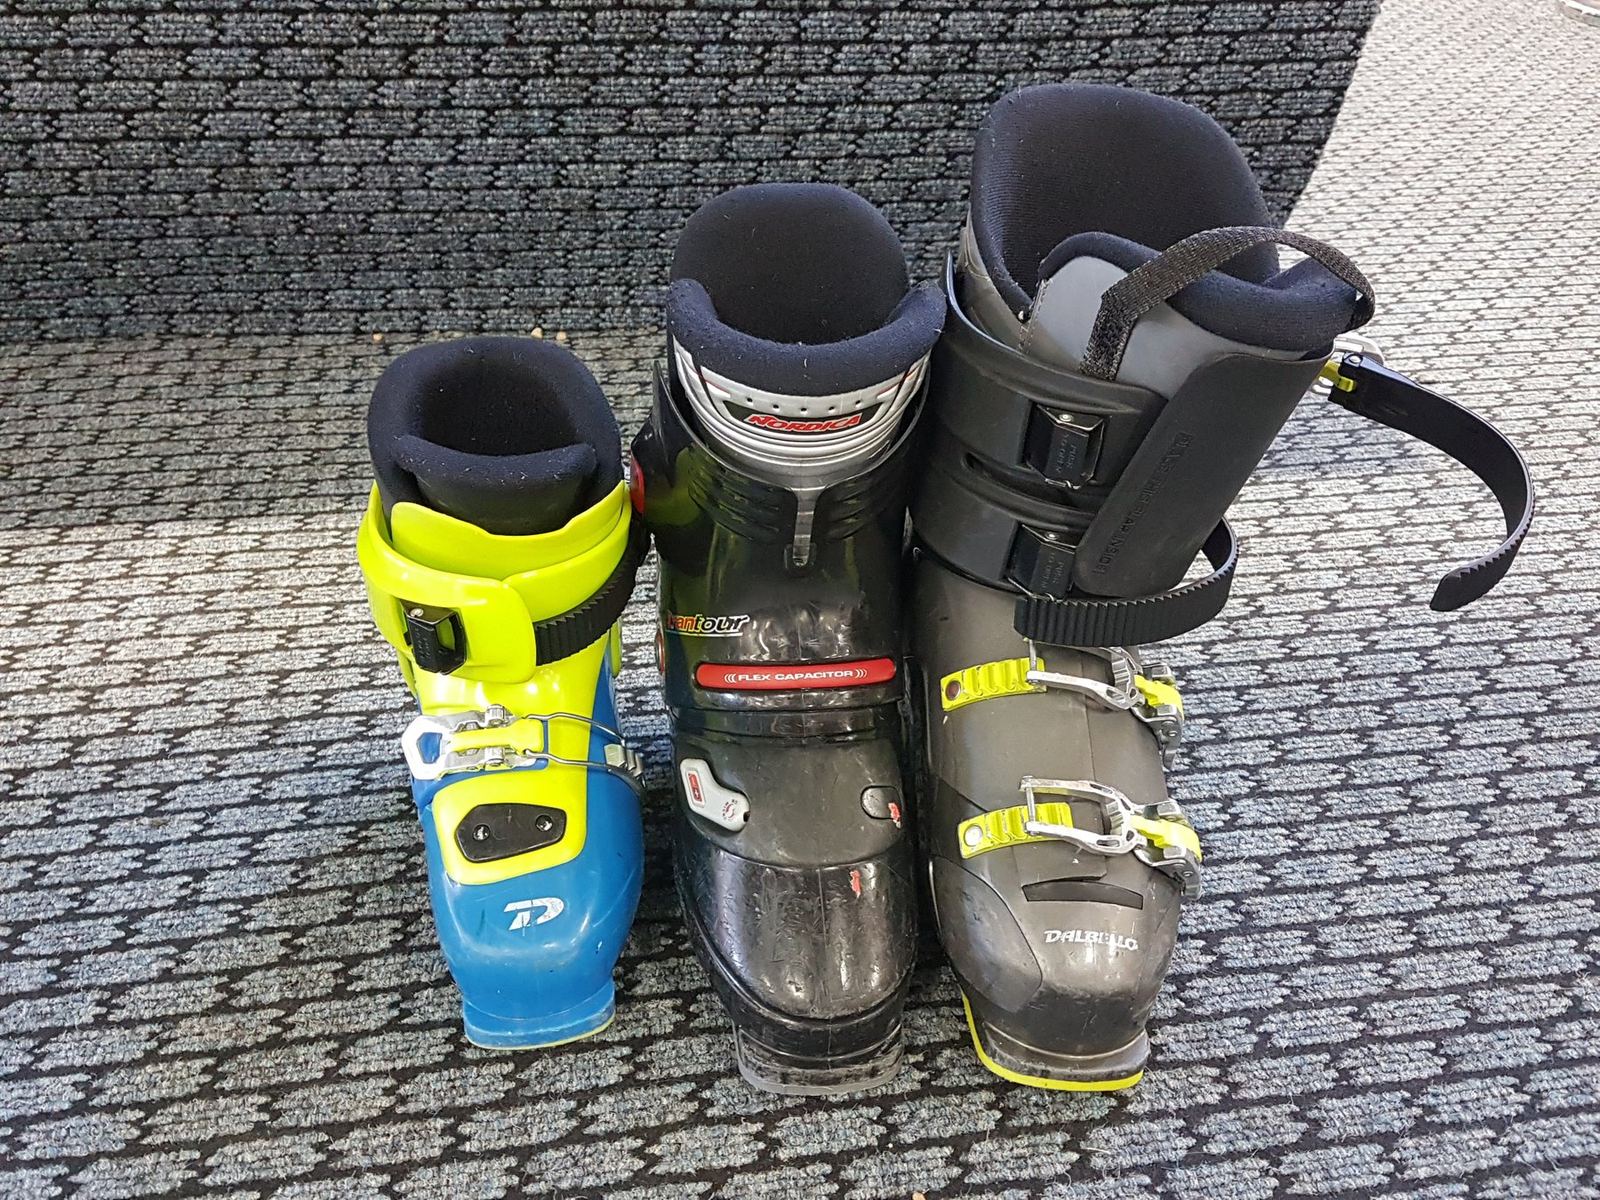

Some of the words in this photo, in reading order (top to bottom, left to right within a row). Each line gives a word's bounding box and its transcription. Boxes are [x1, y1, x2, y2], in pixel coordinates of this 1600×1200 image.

[744, 413, 862, 432] NORDICA
[737, 673, 771, 682] FLEX
[774, 669, 854, 681] CAPACITOR
[1043, 929, 1139, 951] DALBELLO
